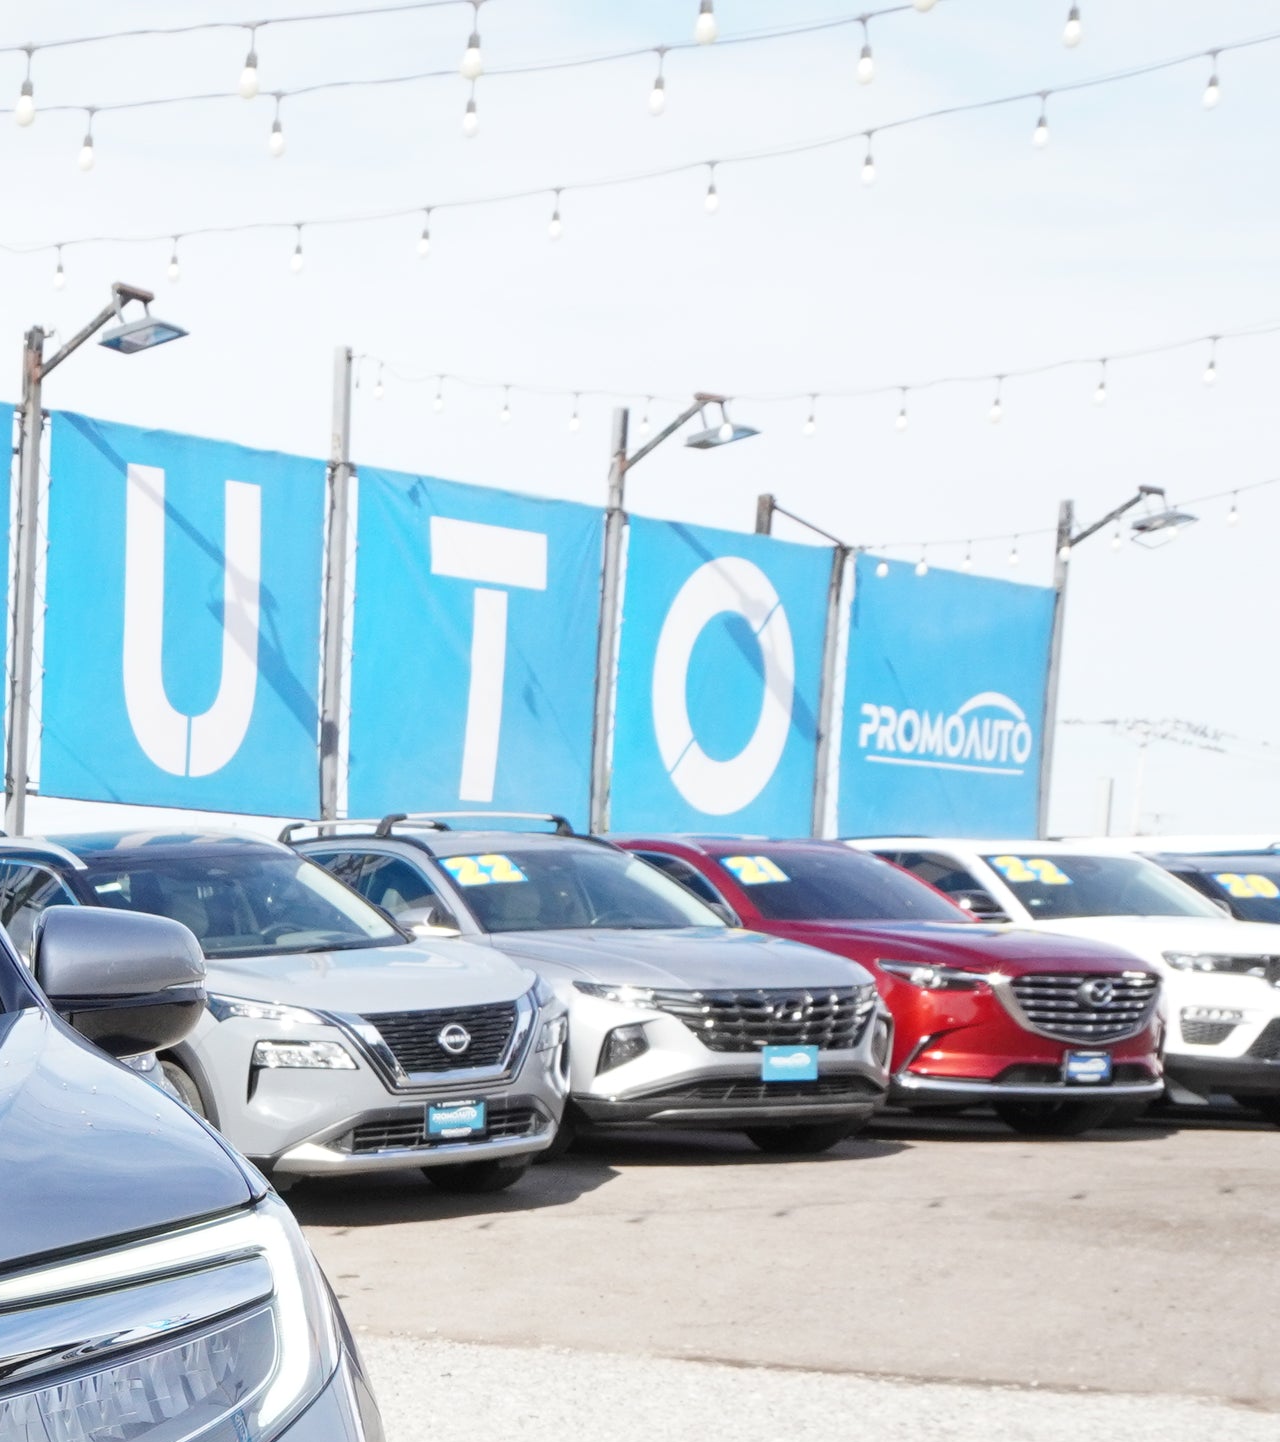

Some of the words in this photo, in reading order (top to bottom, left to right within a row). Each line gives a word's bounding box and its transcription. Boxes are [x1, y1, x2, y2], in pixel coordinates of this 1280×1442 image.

[858, 702, 1033, 764] PROMOAUTO
[443, 854, 523, 886] 22
[725, 856, 787, 885] 21
[992, 855, 1070, 885] 22
